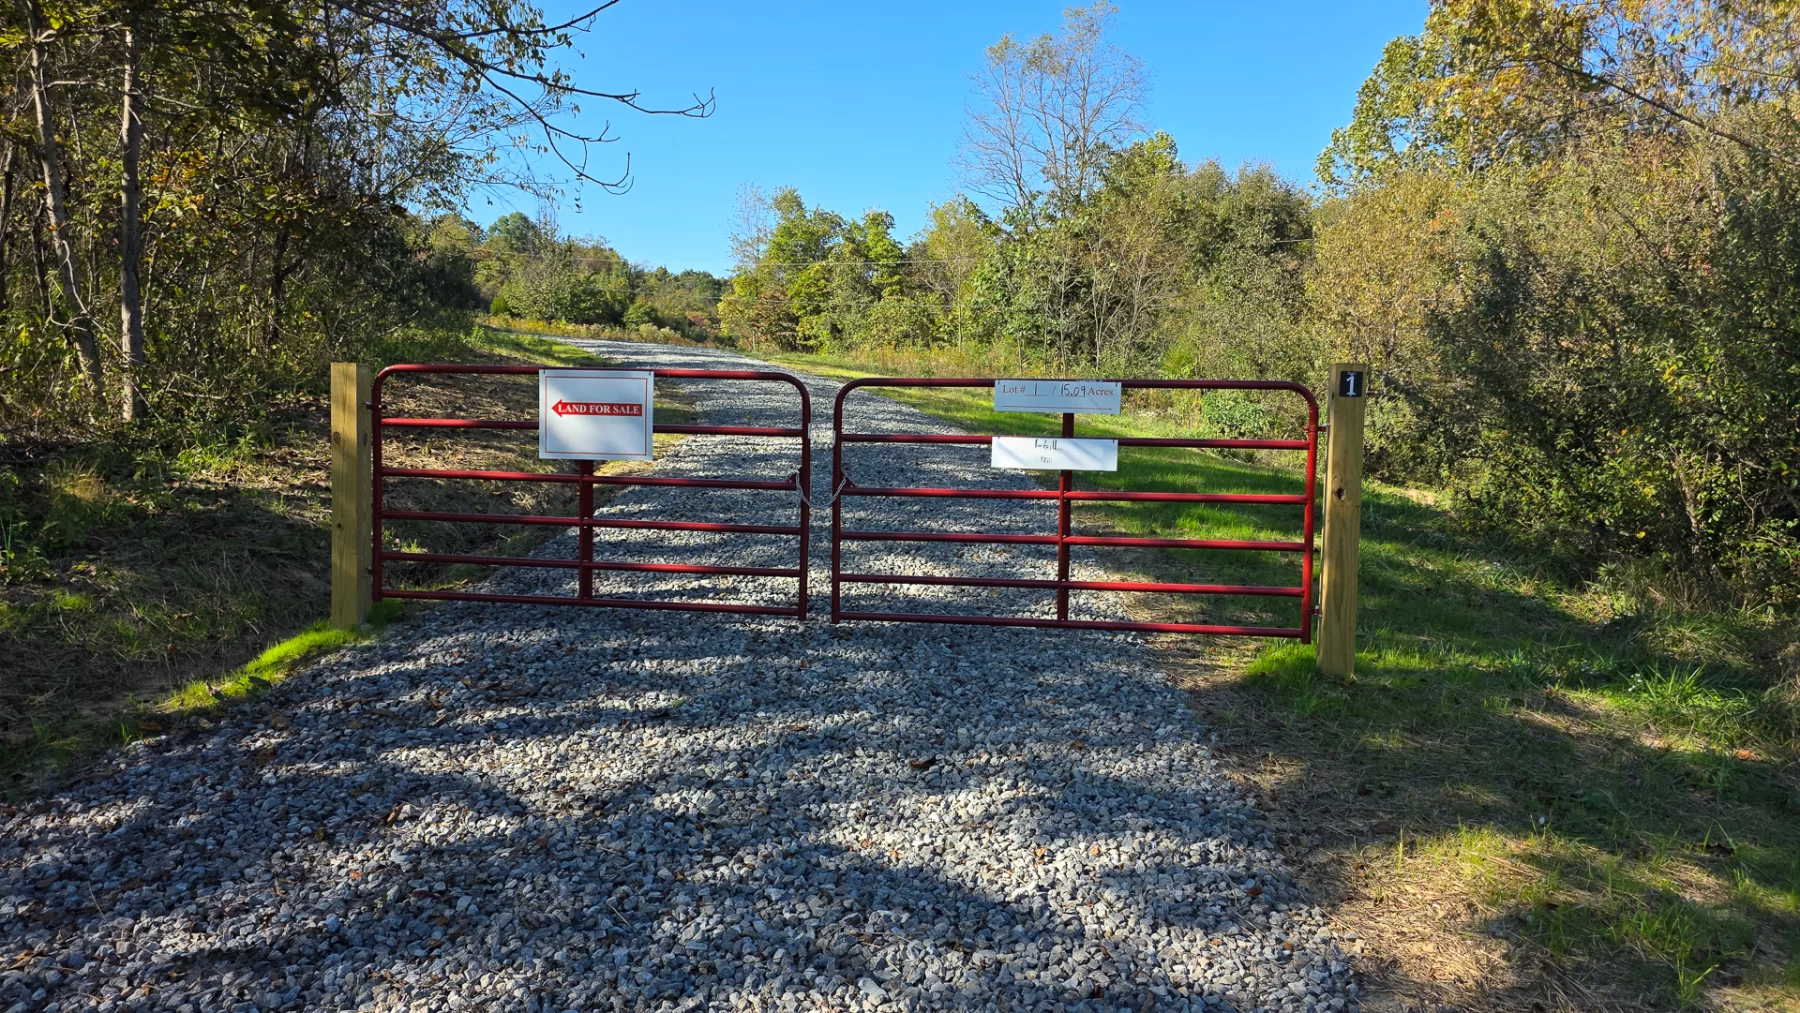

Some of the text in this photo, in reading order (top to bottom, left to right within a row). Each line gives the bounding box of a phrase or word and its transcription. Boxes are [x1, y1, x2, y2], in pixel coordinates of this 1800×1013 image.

[1002, 385, 1017, 394] Lot
[1020, 385, 1026, 393] #
[1060, 383, 1086, 397] 15.09
[1088, 387, 1114, 396] Acres
[1346, 376, 1356, 397] 1
[558, 404, 640, 414] LAND FOR SALE
